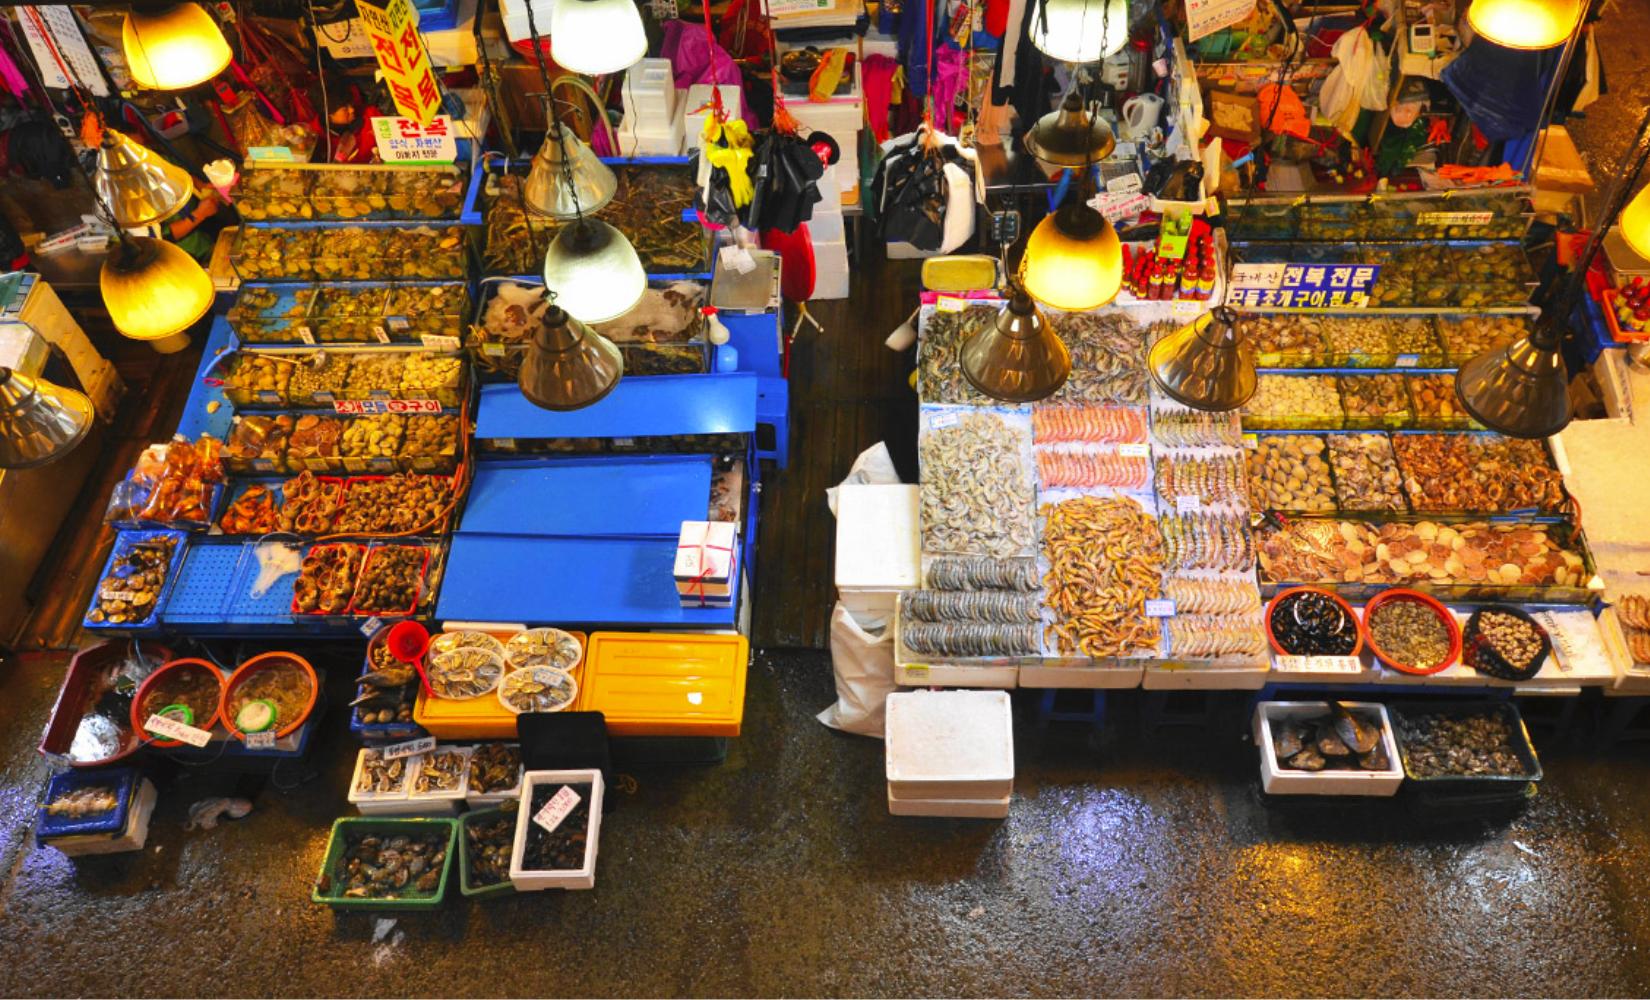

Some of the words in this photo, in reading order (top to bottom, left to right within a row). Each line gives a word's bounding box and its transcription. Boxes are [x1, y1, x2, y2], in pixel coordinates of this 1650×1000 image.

[397, 118, 447, 138] 전복
[1283, 266, 1327, 287] 전복
[1330, 267, 1373, 288] 전문
